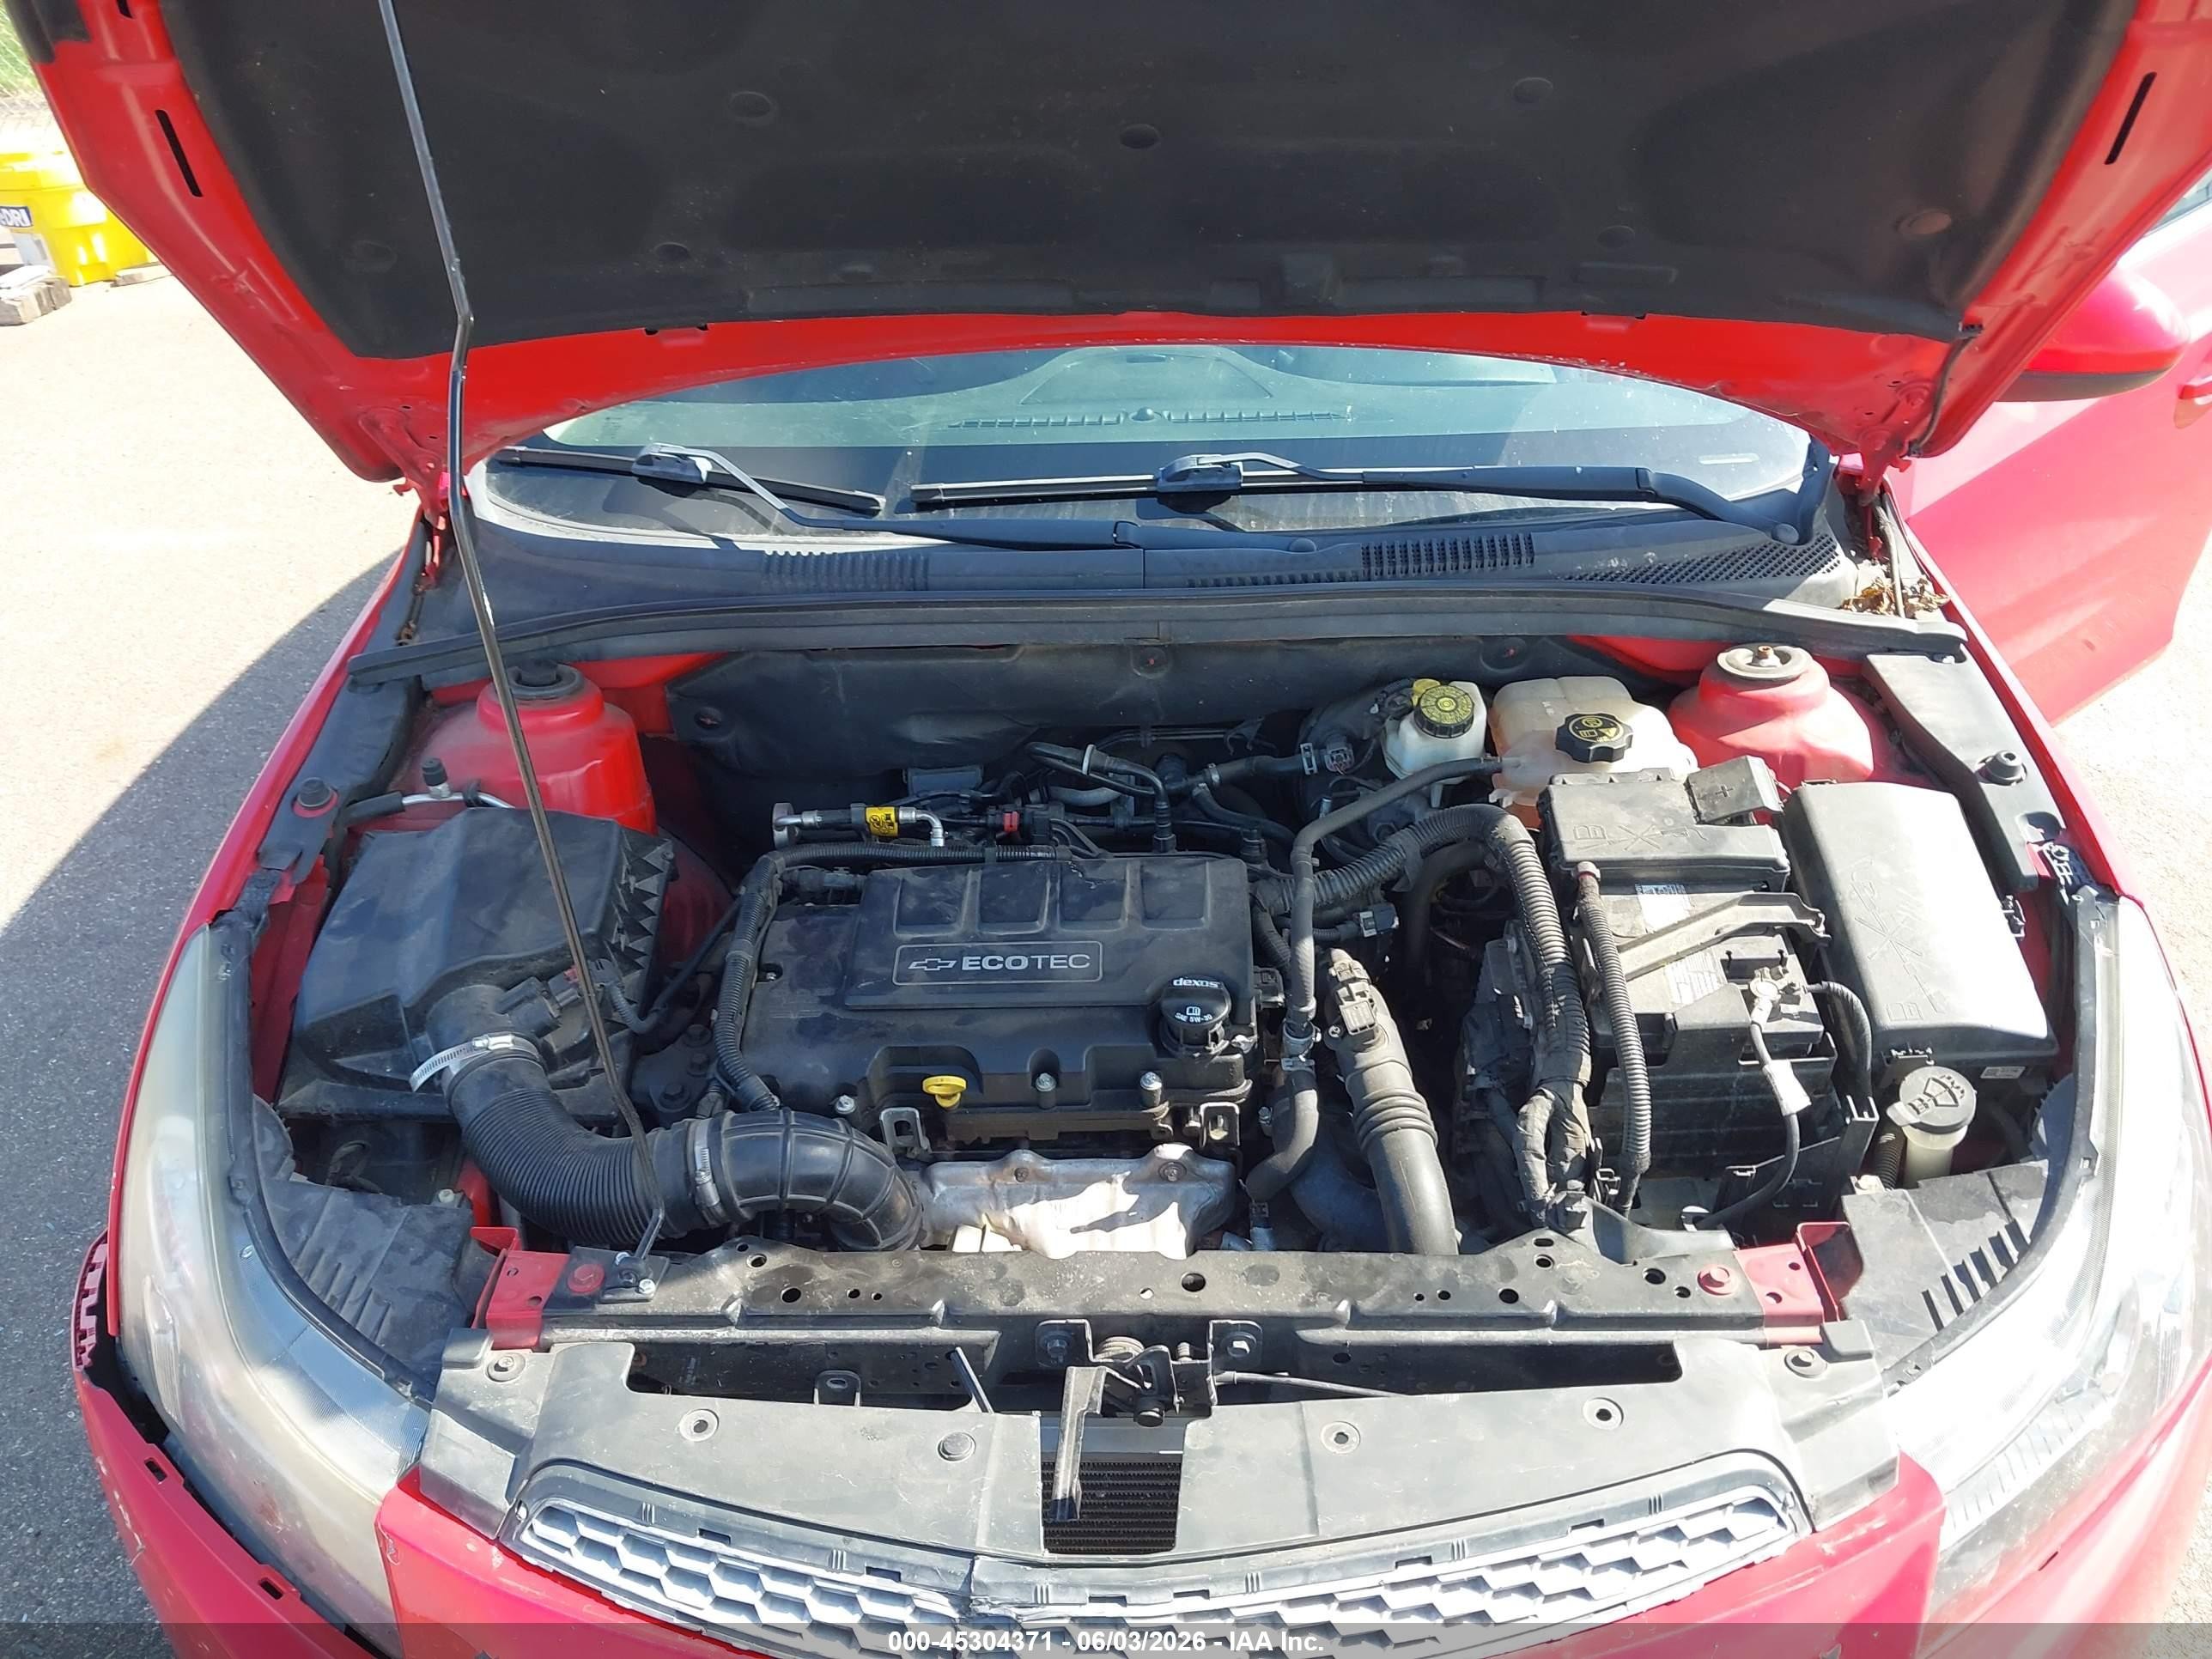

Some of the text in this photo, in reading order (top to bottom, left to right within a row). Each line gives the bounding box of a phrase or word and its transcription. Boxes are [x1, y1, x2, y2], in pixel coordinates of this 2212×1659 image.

[962, 954, 1091, 970] ECOTEC
[1173, 977, 1220, 988] dexos
[1175, 1012, 1212, 1023] SAE 5W-30
